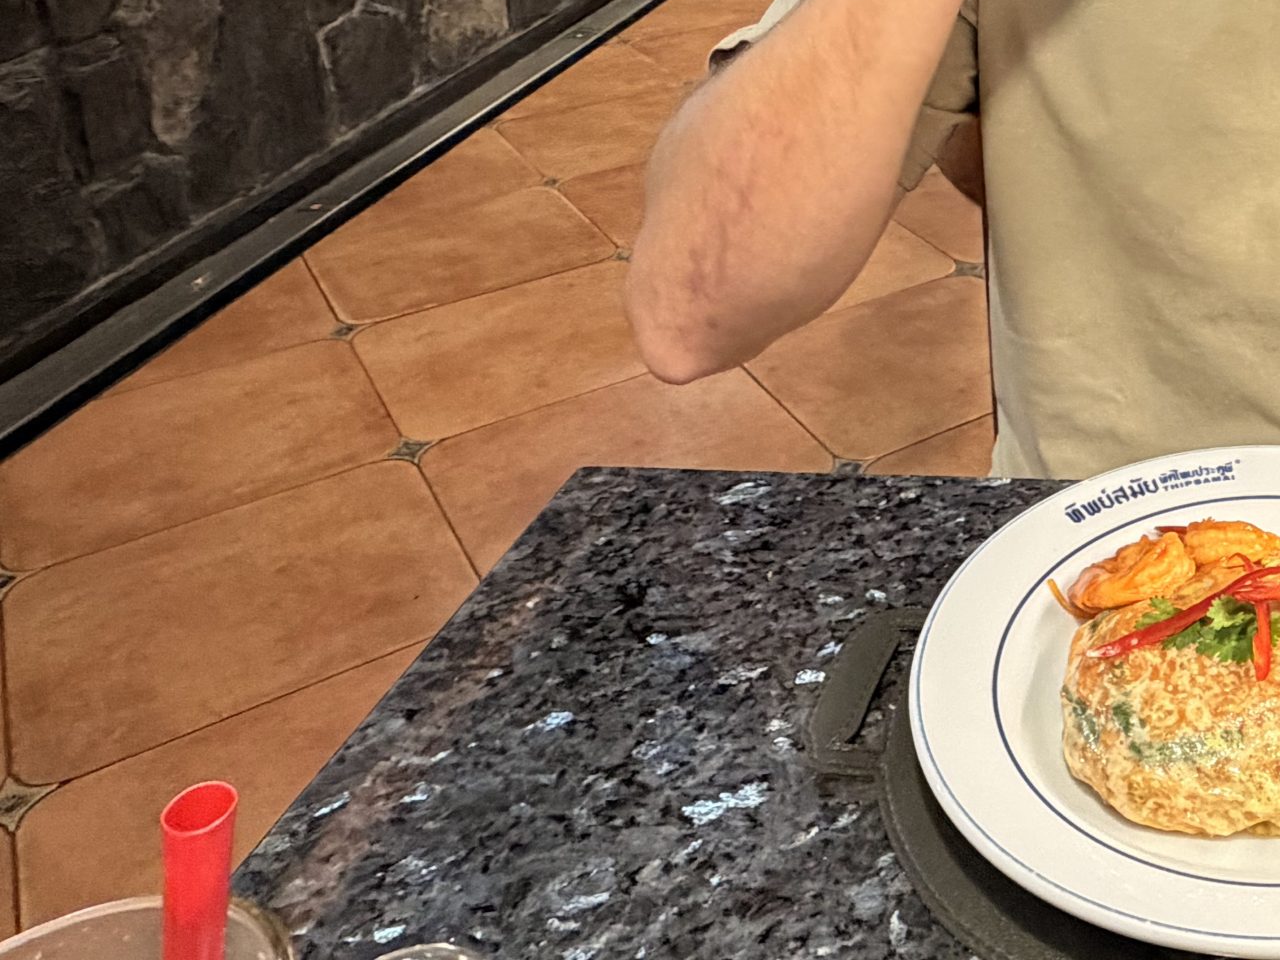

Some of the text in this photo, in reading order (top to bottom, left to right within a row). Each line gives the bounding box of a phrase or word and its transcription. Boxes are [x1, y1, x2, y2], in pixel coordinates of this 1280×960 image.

[1162, 475, 1236, 492] THIPSAMAI
[1065, 477, 1159, 524] ทิพย์สมัย
